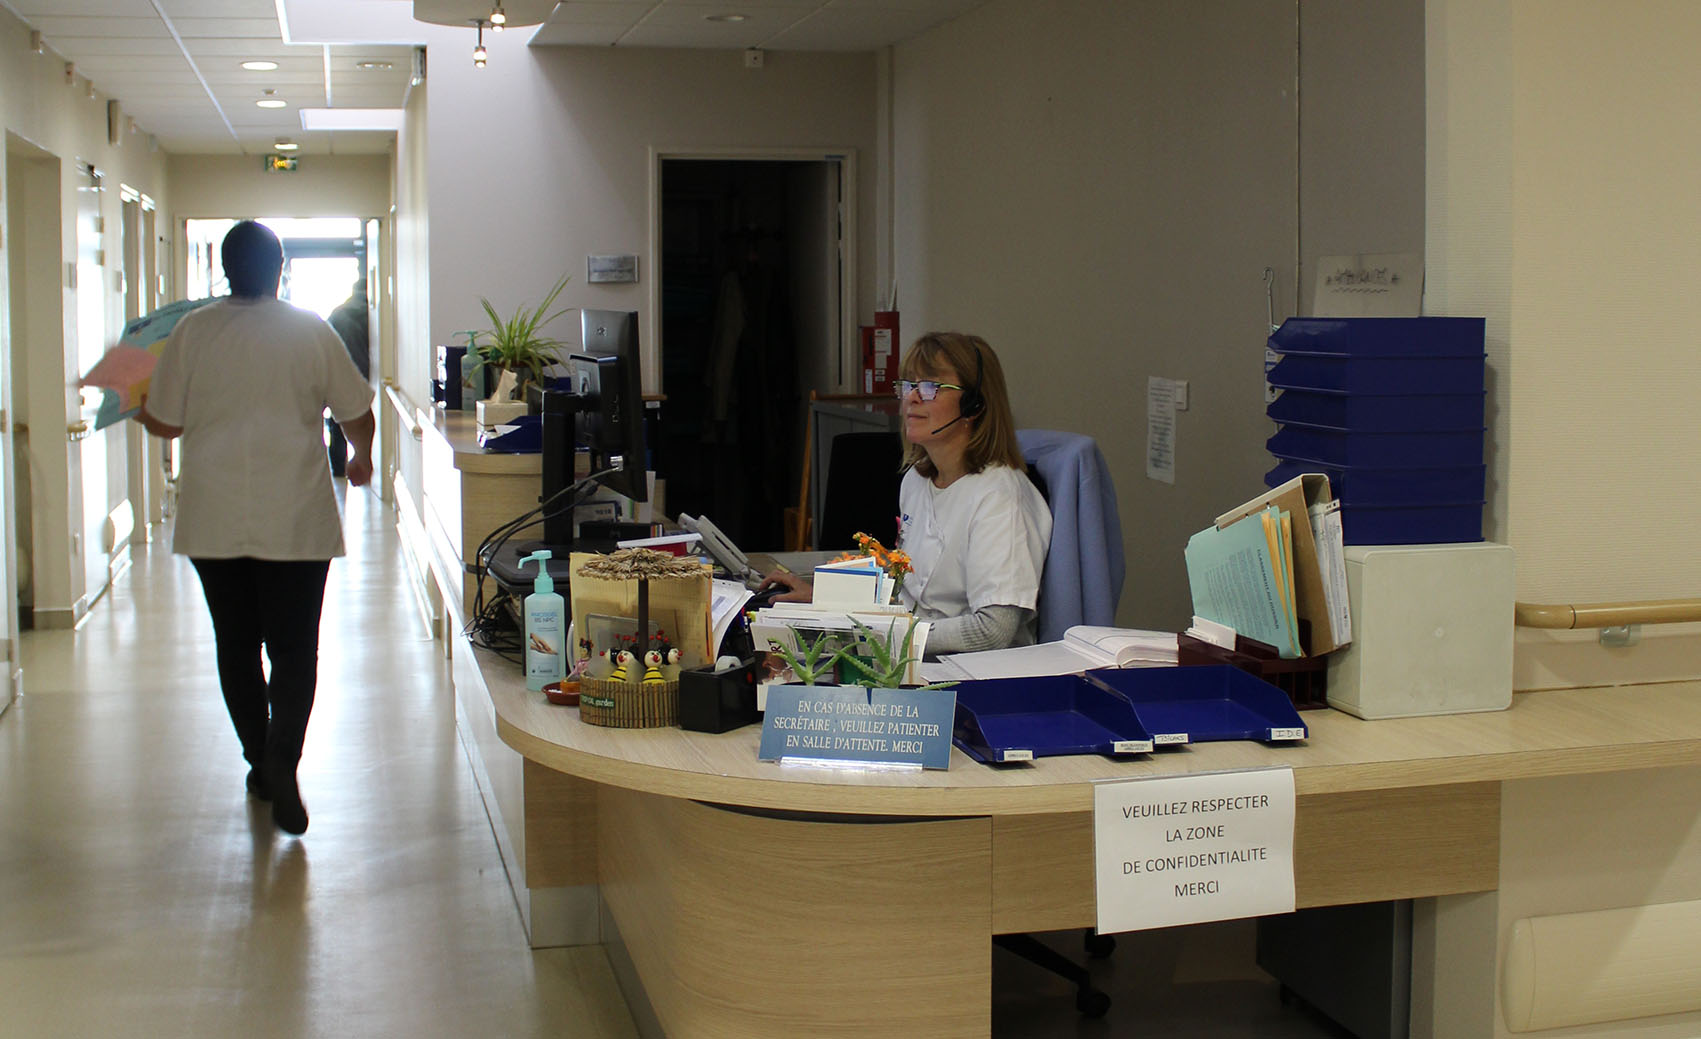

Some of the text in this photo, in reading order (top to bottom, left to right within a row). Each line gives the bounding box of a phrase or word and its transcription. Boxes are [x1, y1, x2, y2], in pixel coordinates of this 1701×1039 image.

[798, 701, 919, 718] EN CAS D'ABSENCE DE LA
[774, 716, 830, 731] SECRÉTAIRE
[841, 719, 885, 735] VEUILLEZ
[888, 724, 940, 737] PATIENTER
[786, 735, 923, 754] EN SALLE D'ATTENTE. MERCI
[1122, 795, 1269, 818] VEUILLEZ RESPECTER
[1166, 825, 1225, 843] LA ZONE
[1123, 847, 1267, 875] DE CONFIDENTIALITE
[1174, 880, 1219, 898] MERCI
